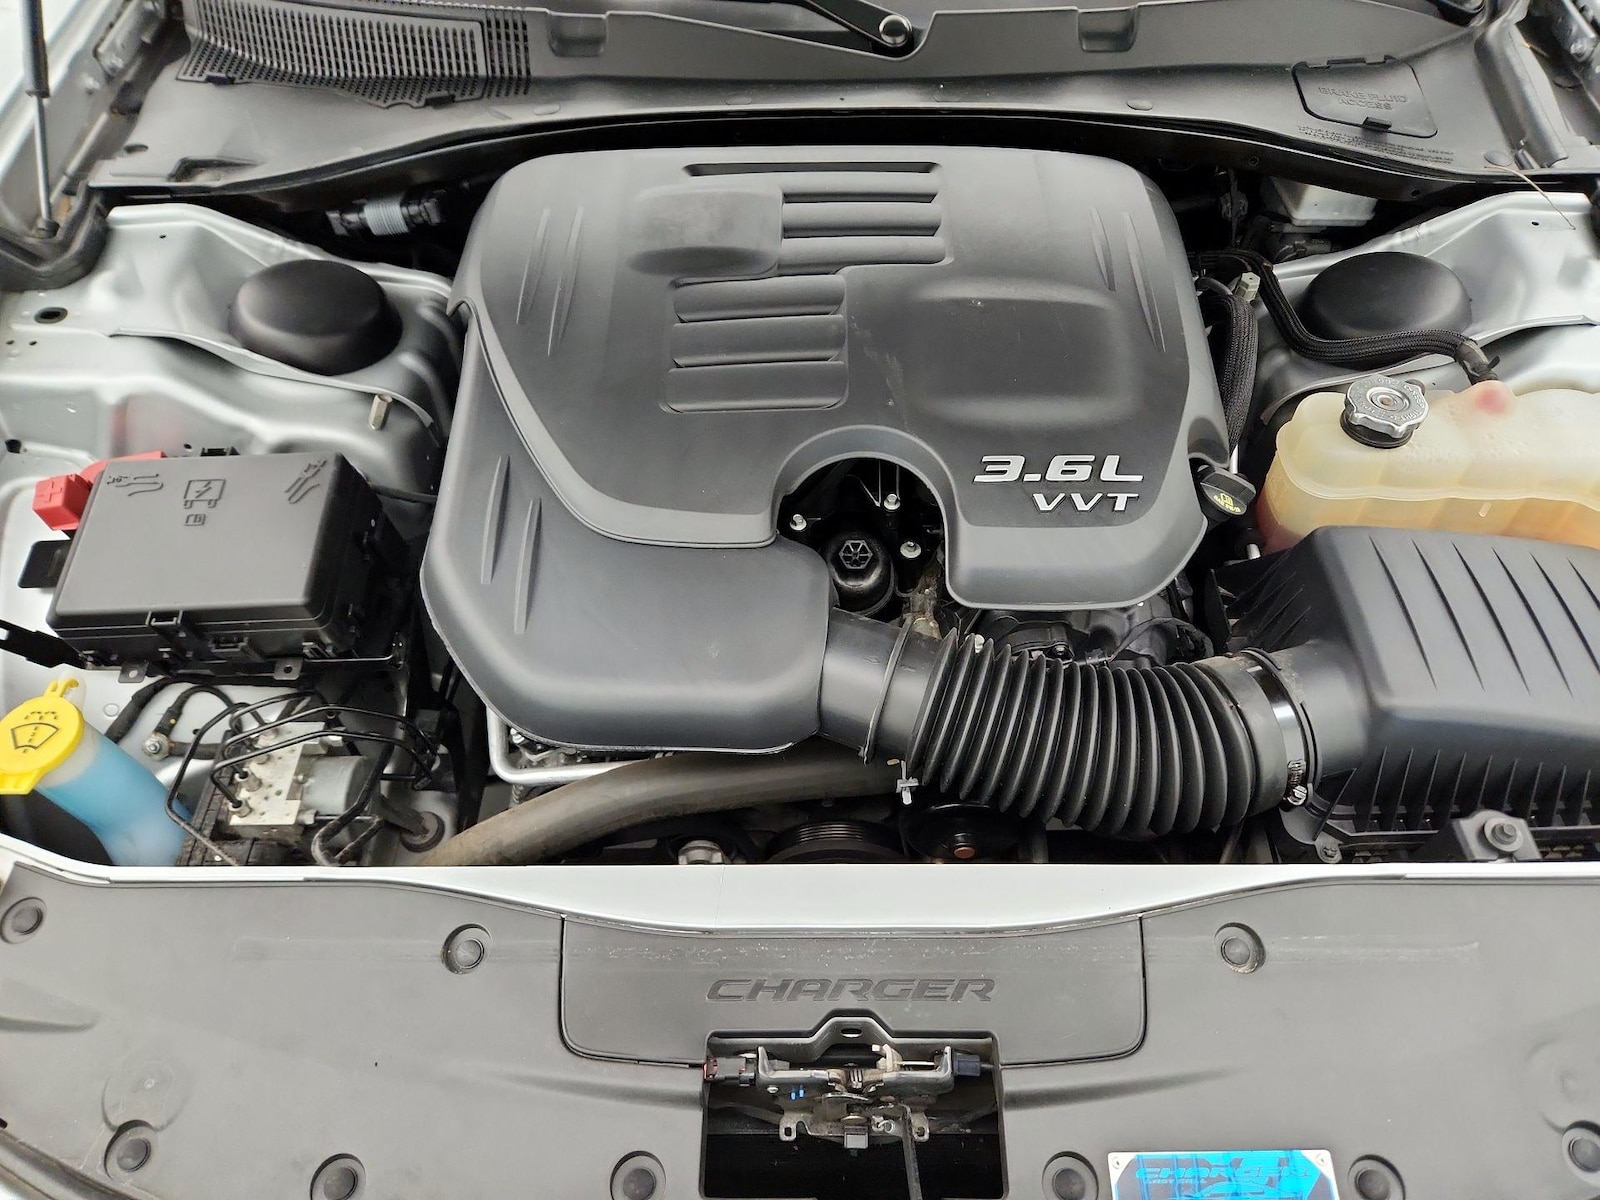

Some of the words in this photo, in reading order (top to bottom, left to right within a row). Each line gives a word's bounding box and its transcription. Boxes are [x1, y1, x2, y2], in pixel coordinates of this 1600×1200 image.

[1338, 98, 1393, 110] ACCESS
[1368, 93, 1408, 103] FLUID
[973, 454, 1145, 483] 3.6L
[1032, 492, 1140, 513] VVT
[706, 978, 996, 1002] CHARGER
[1136, 1166, 1309, 1179] CHARGER
